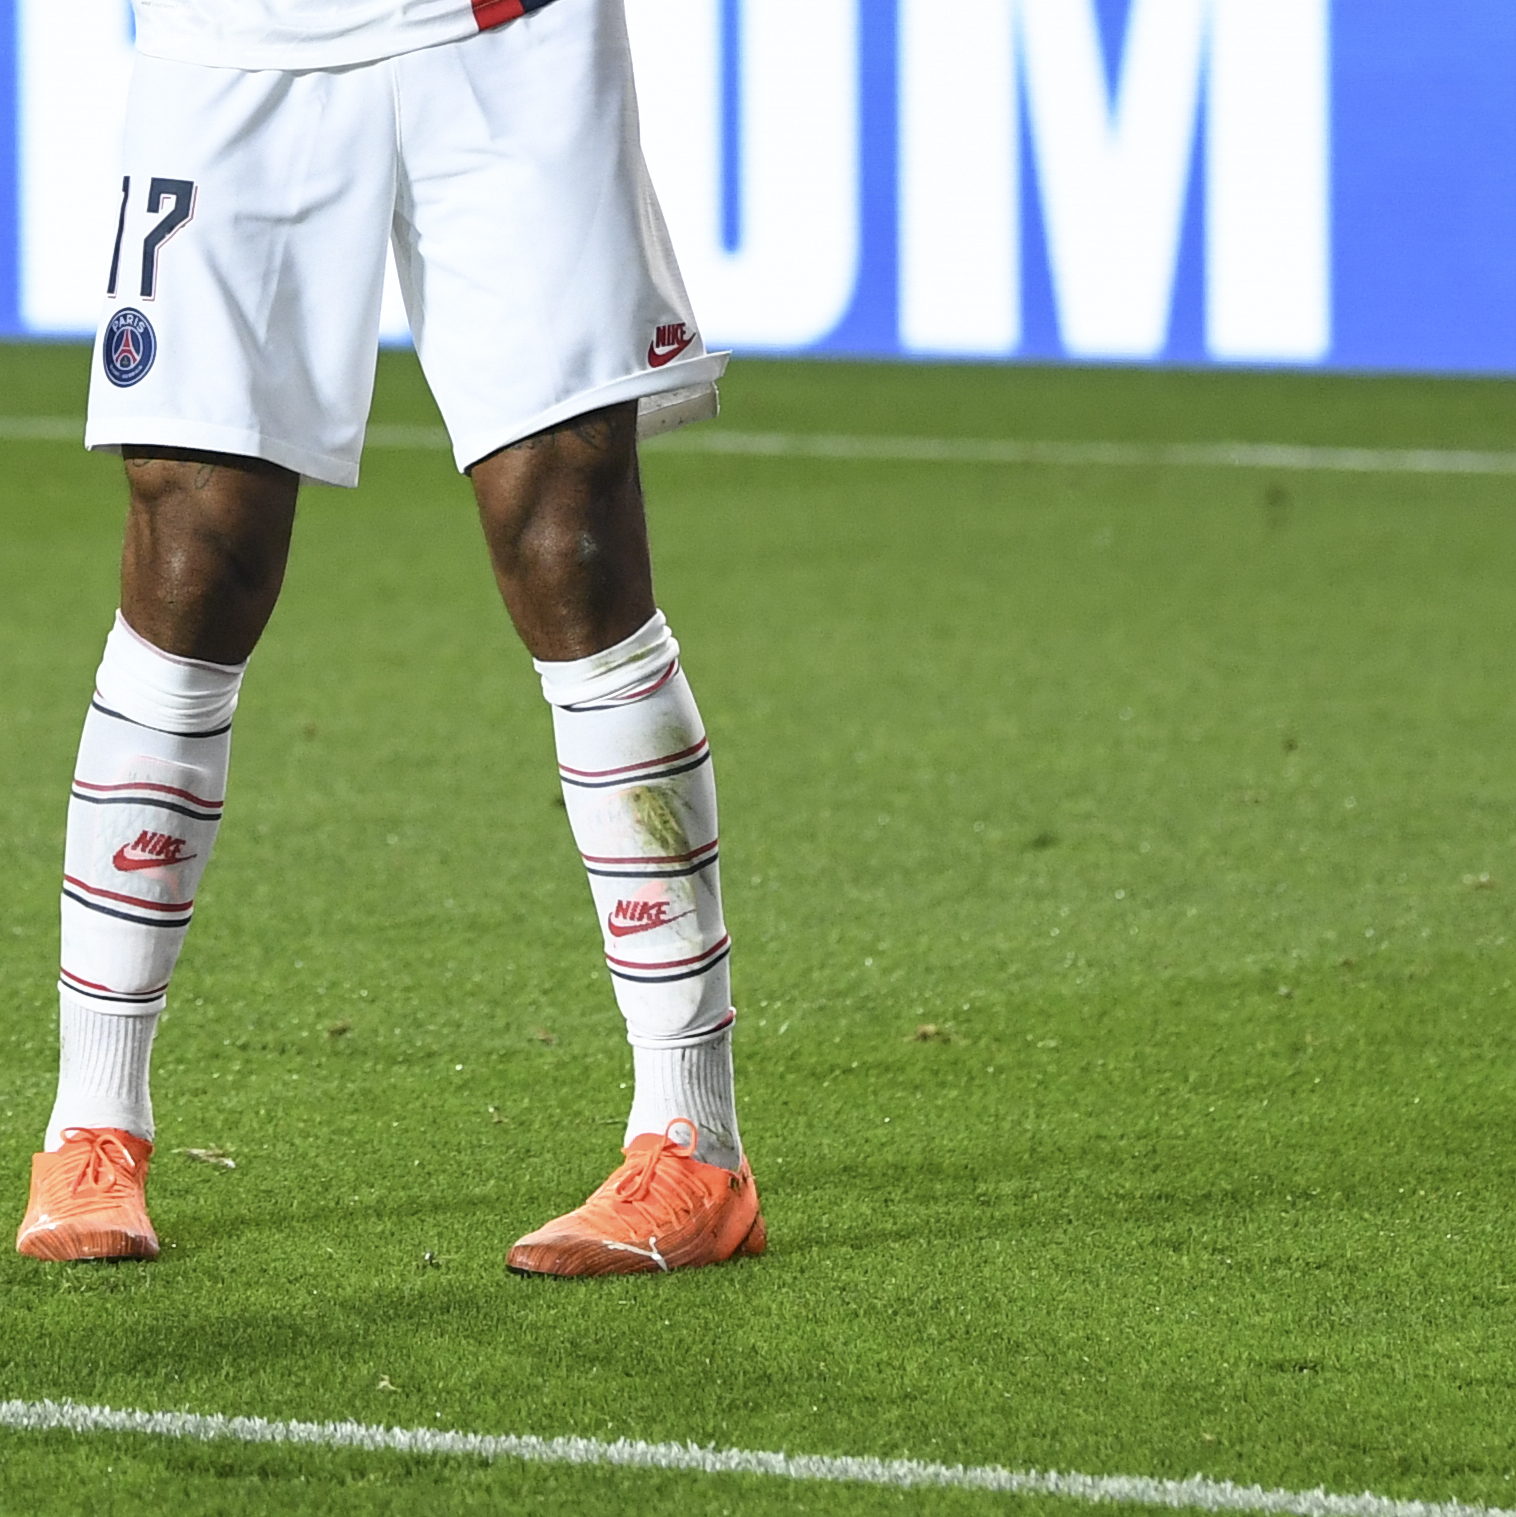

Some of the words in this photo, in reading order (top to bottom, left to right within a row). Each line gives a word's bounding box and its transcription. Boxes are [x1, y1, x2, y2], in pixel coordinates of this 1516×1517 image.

[105, 174, 199, 303] 17
[111, 313, 146, 334] PARIS
[655, 321, 688, 348] NIKE
[130, 829, 187, 860] NIKE
[614, 899, 671, 924] NIKE
